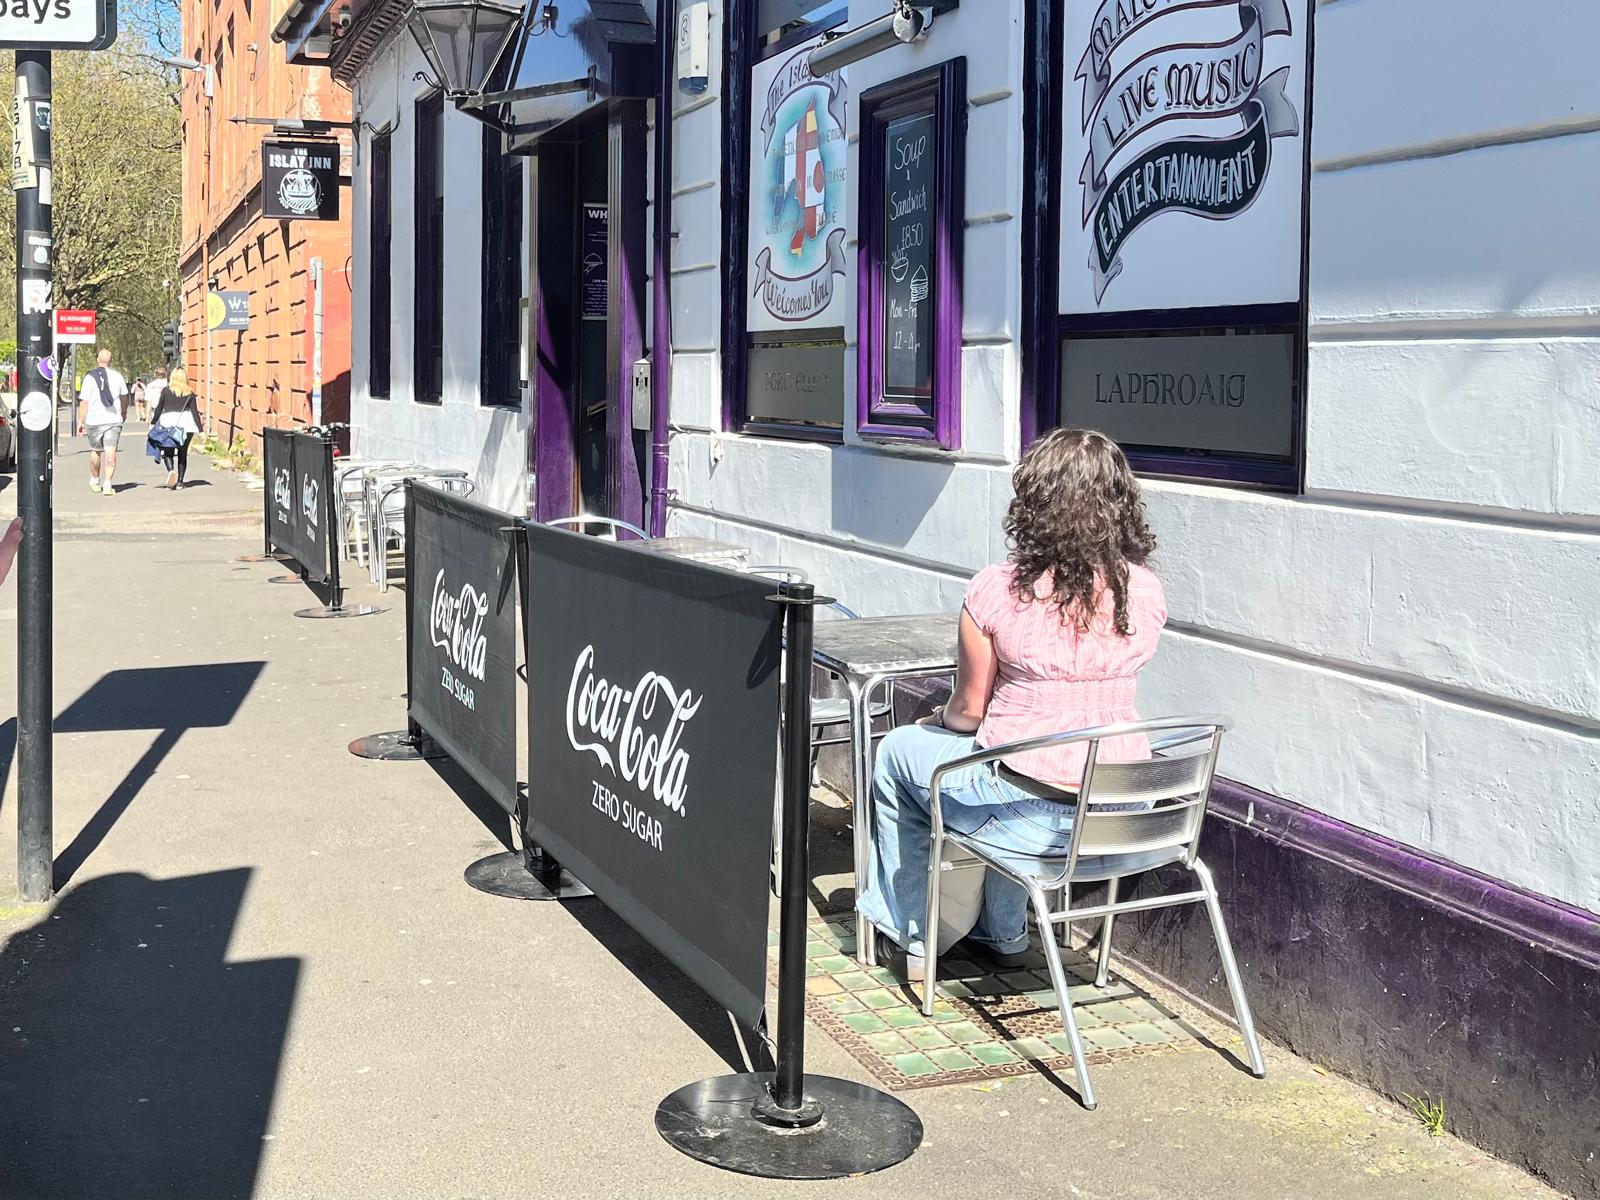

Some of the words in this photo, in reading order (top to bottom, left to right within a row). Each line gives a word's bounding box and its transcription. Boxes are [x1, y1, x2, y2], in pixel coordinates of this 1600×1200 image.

[770, 79, 785, 113] The
[1102, 66, 1159, 147] LIVE
[1165, 41, 1257, 110] MUSIC
[269, 154, 306, 169] ISLAY
[308, 156, 332, 170] INN
[294, 148, 308, 156] THE
[894, 135, 926, 170] Soup
[890, 184, 927, 221] Sandwich
[1098, 140, 1256, 258] ENTERTAINMENT
[811, 279, 830, 308] You
[1095, 372, 1247, 408] LAPHROAIG
[430, 567, 489, 683] Coca-Cola
[441, 666, 454, 695] ZERO
[454, 678, 475, 711] SUGAR
[566, 644, 704, 813] Coca-Cola
[592, 780, 620, 822] ZERO
[622, 800, 663, 851] SUGAR
